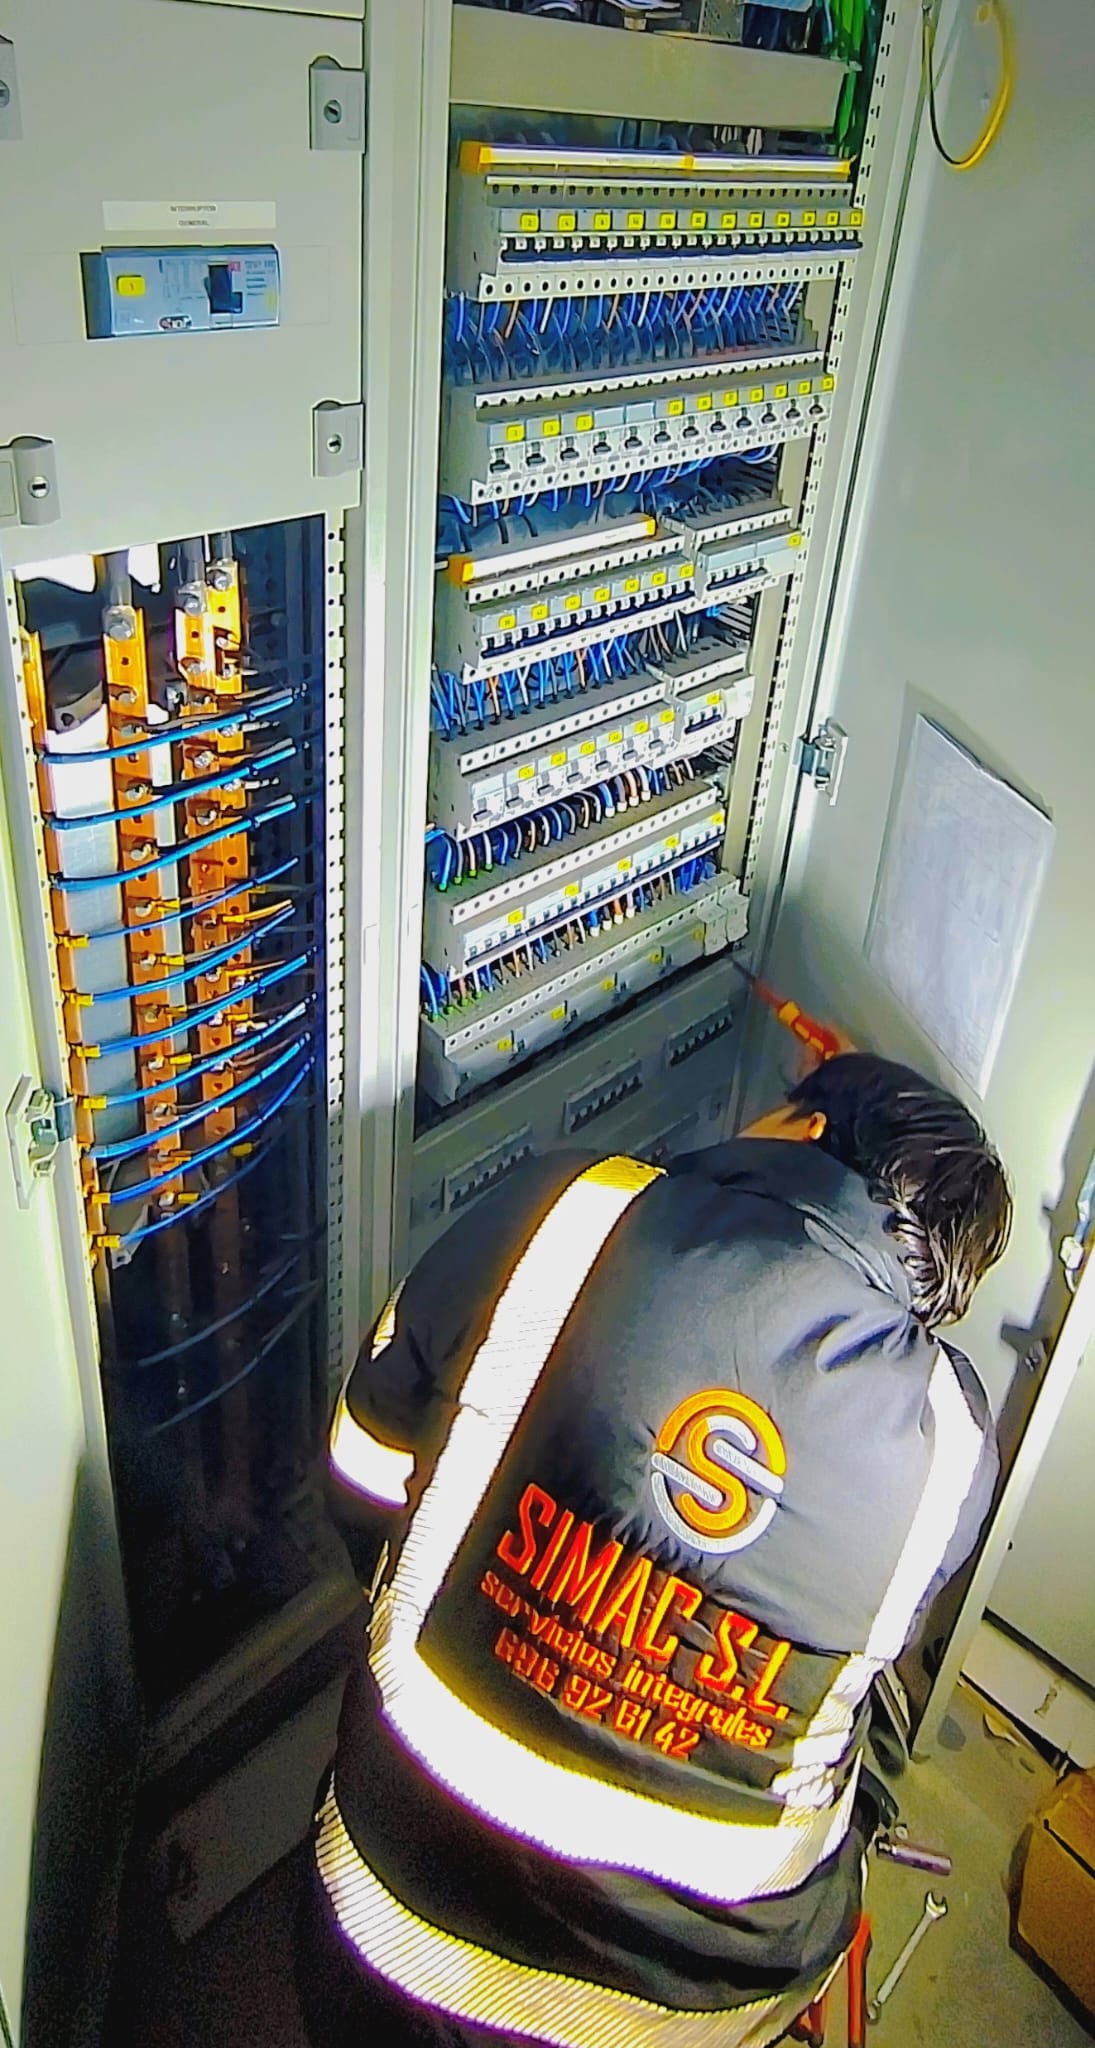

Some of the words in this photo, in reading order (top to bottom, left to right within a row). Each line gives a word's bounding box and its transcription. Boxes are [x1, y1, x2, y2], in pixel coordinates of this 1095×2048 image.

[481, 1570, 618, 1680] servicios
[621, 1658, 774, 1748] integrales
[497, 1483, 703, 1662] SIMAC
[495, 1627, 560, 1693] 696
[562, 1673, 613, 1720] 92
[613, 1699, 653, 1741] 61
[652, 1720, 700, 1760] 42
